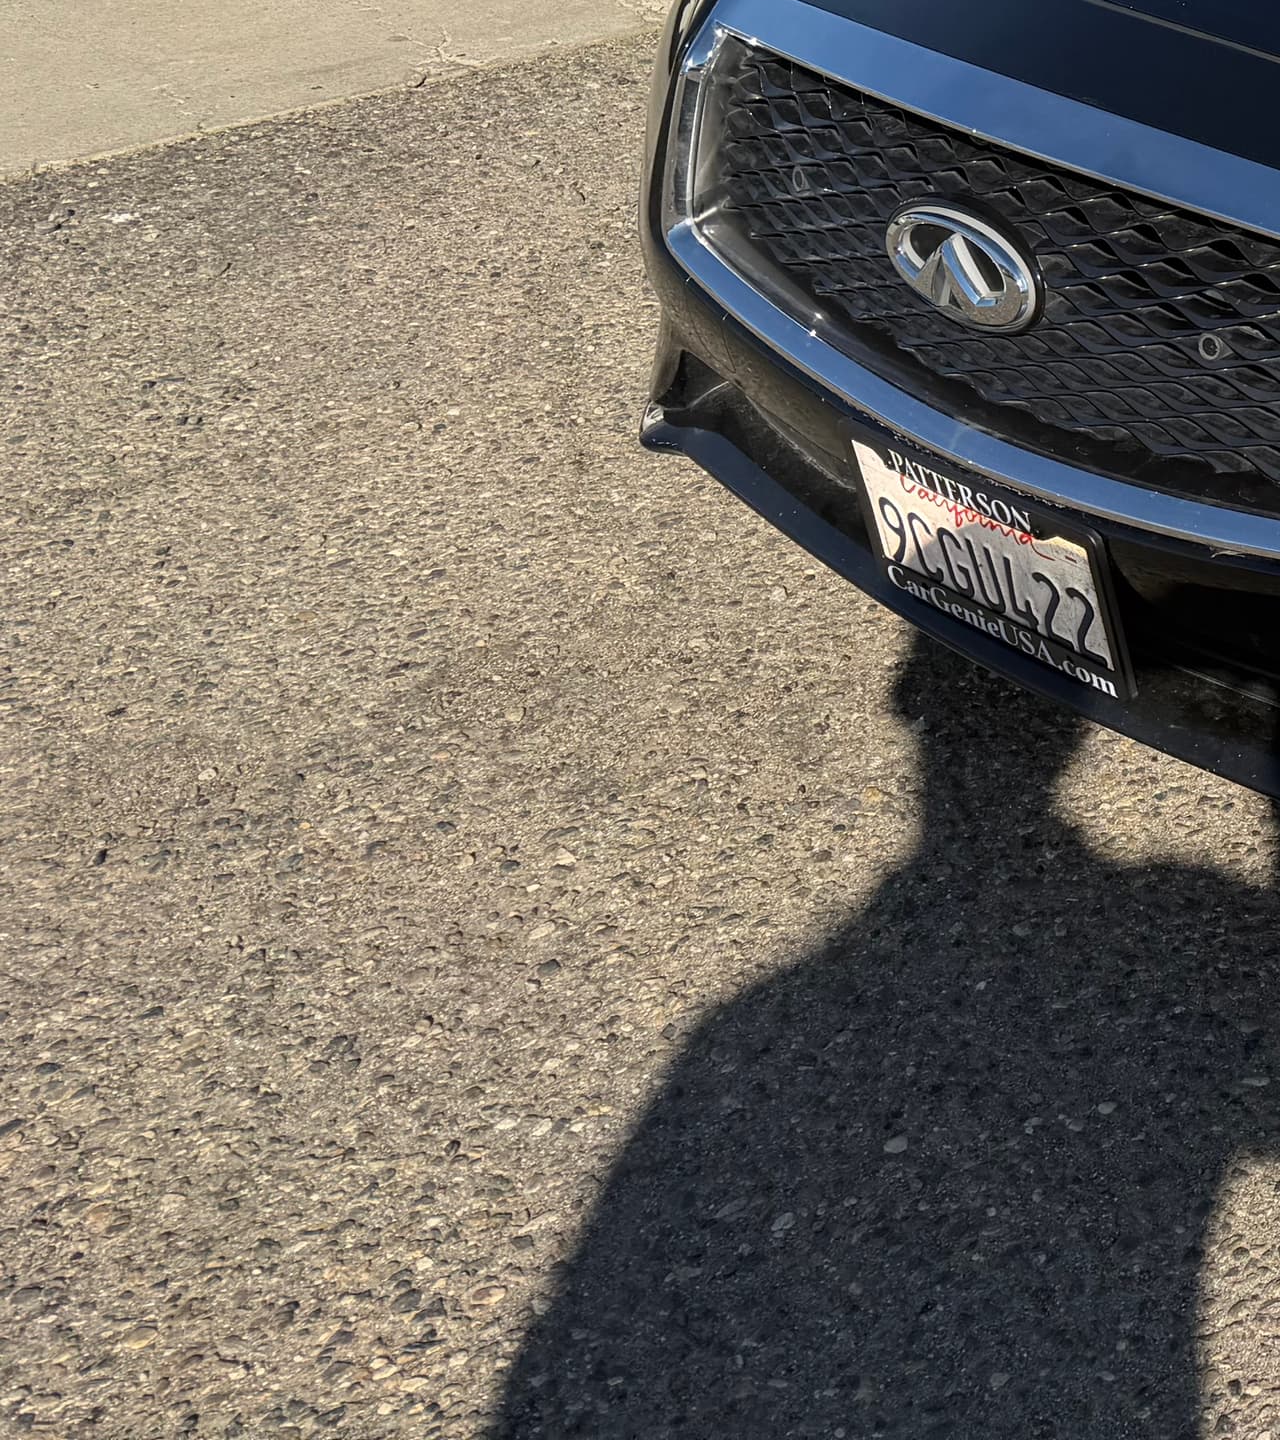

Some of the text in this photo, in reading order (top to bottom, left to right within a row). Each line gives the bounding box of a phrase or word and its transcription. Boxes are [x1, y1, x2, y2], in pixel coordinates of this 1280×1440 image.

[888, 449, 1031, 531] PATTERSON
[879, 496, 1109, 670] 9CGU422
[887, 564, 1118, 699] CarGenieUSA.com
